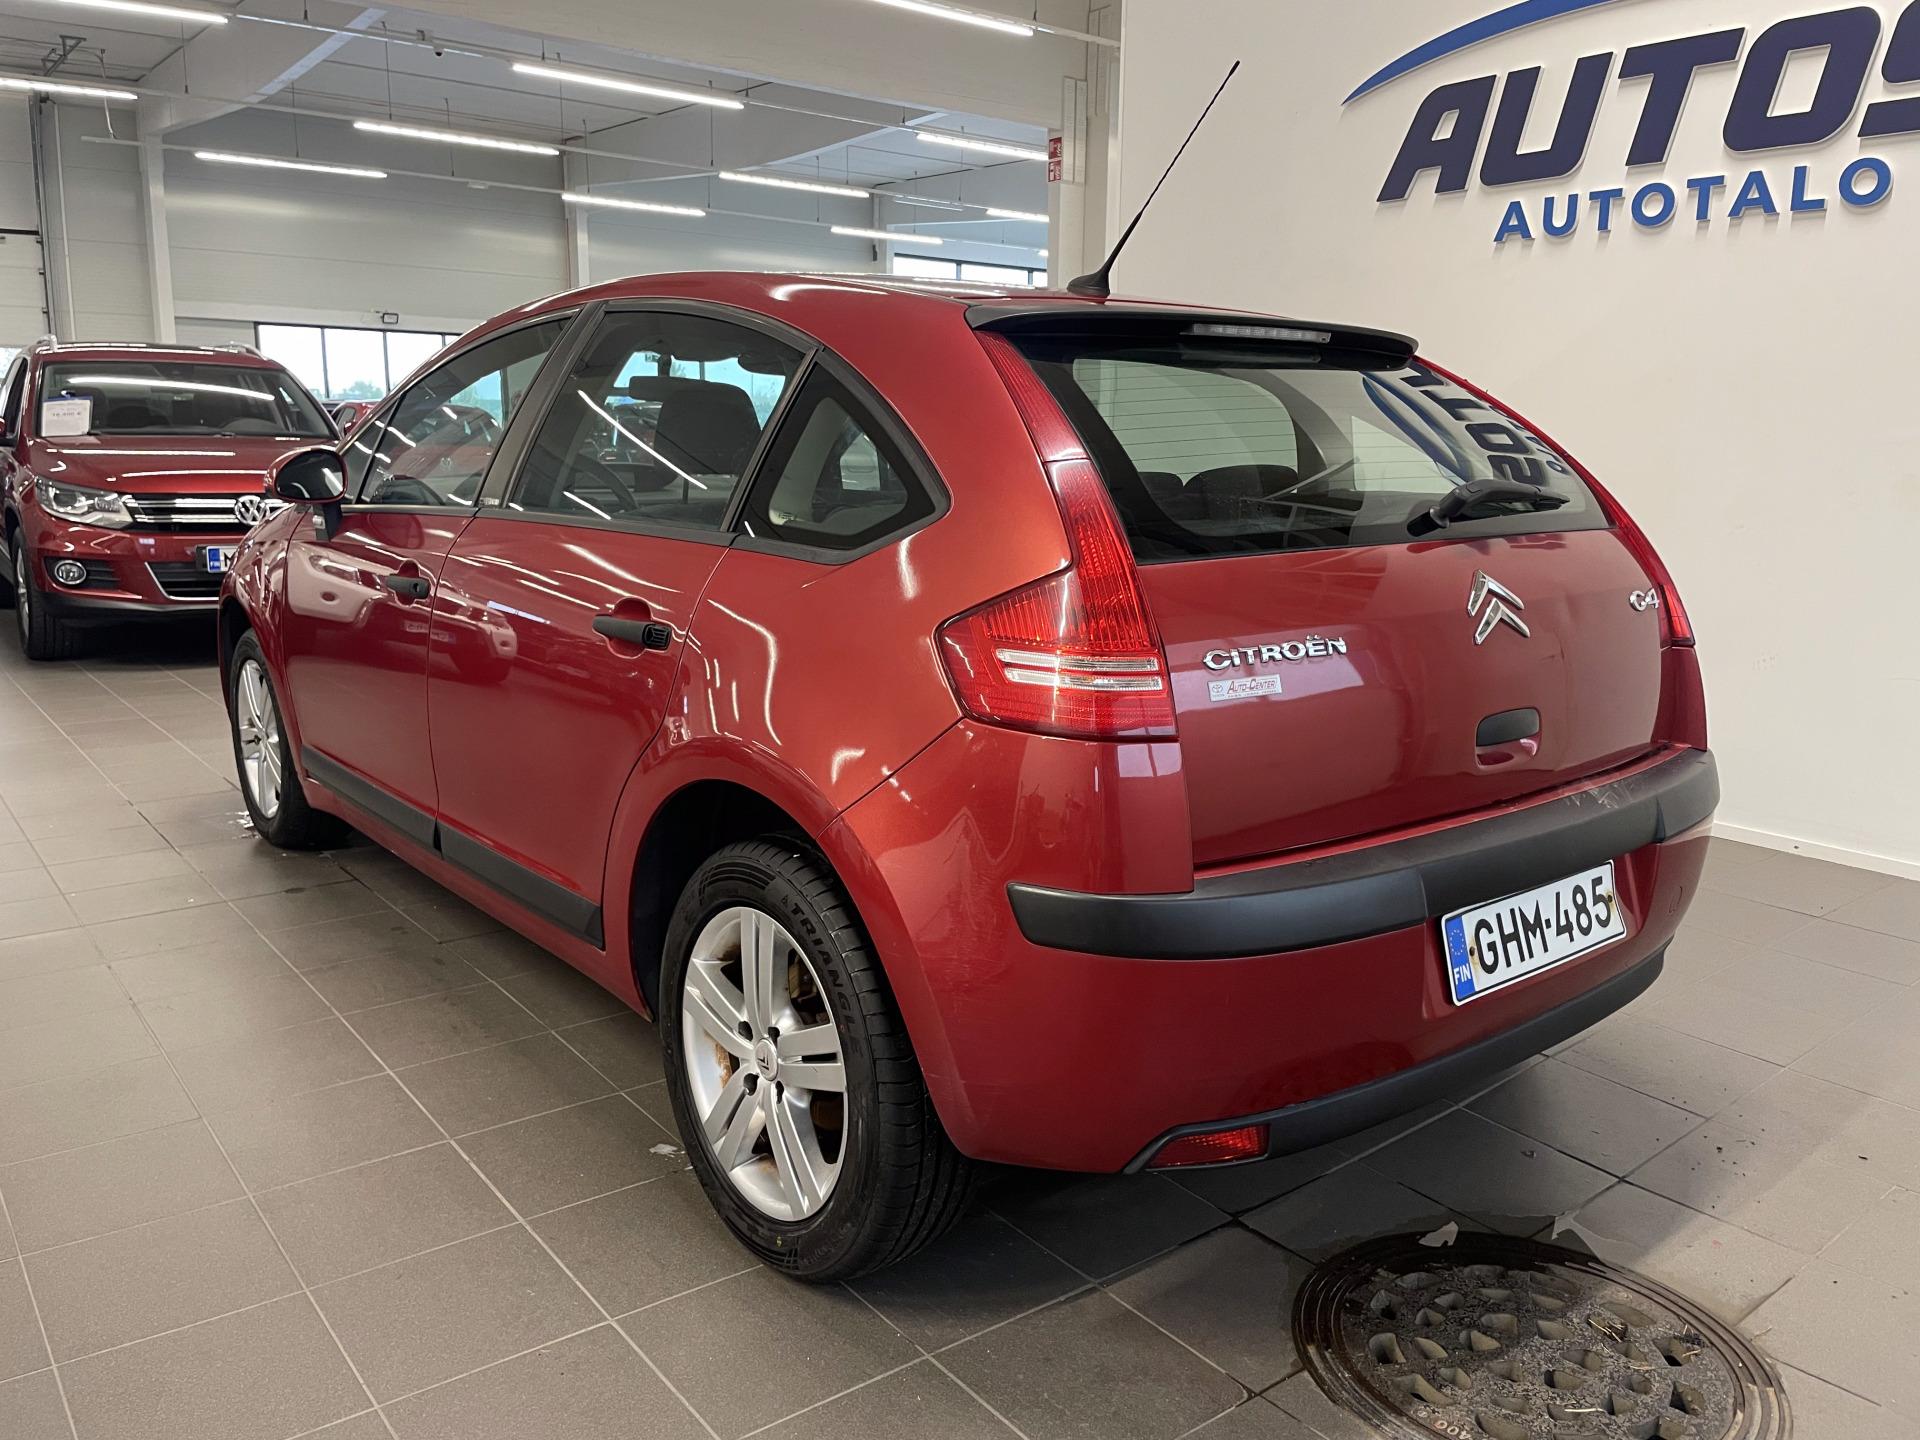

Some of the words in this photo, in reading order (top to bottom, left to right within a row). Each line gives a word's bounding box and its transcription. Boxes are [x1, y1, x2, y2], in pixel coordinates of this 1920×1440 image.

[1493, 157, 1892, 243] AUTOTALO
[1629, 588, 1660, 612] C4
[1203, 634, 1347, 671] CITROËN
[1474, 876, 1612, 975] GHM-485
[1453, 963, 1472, 985] FIN
